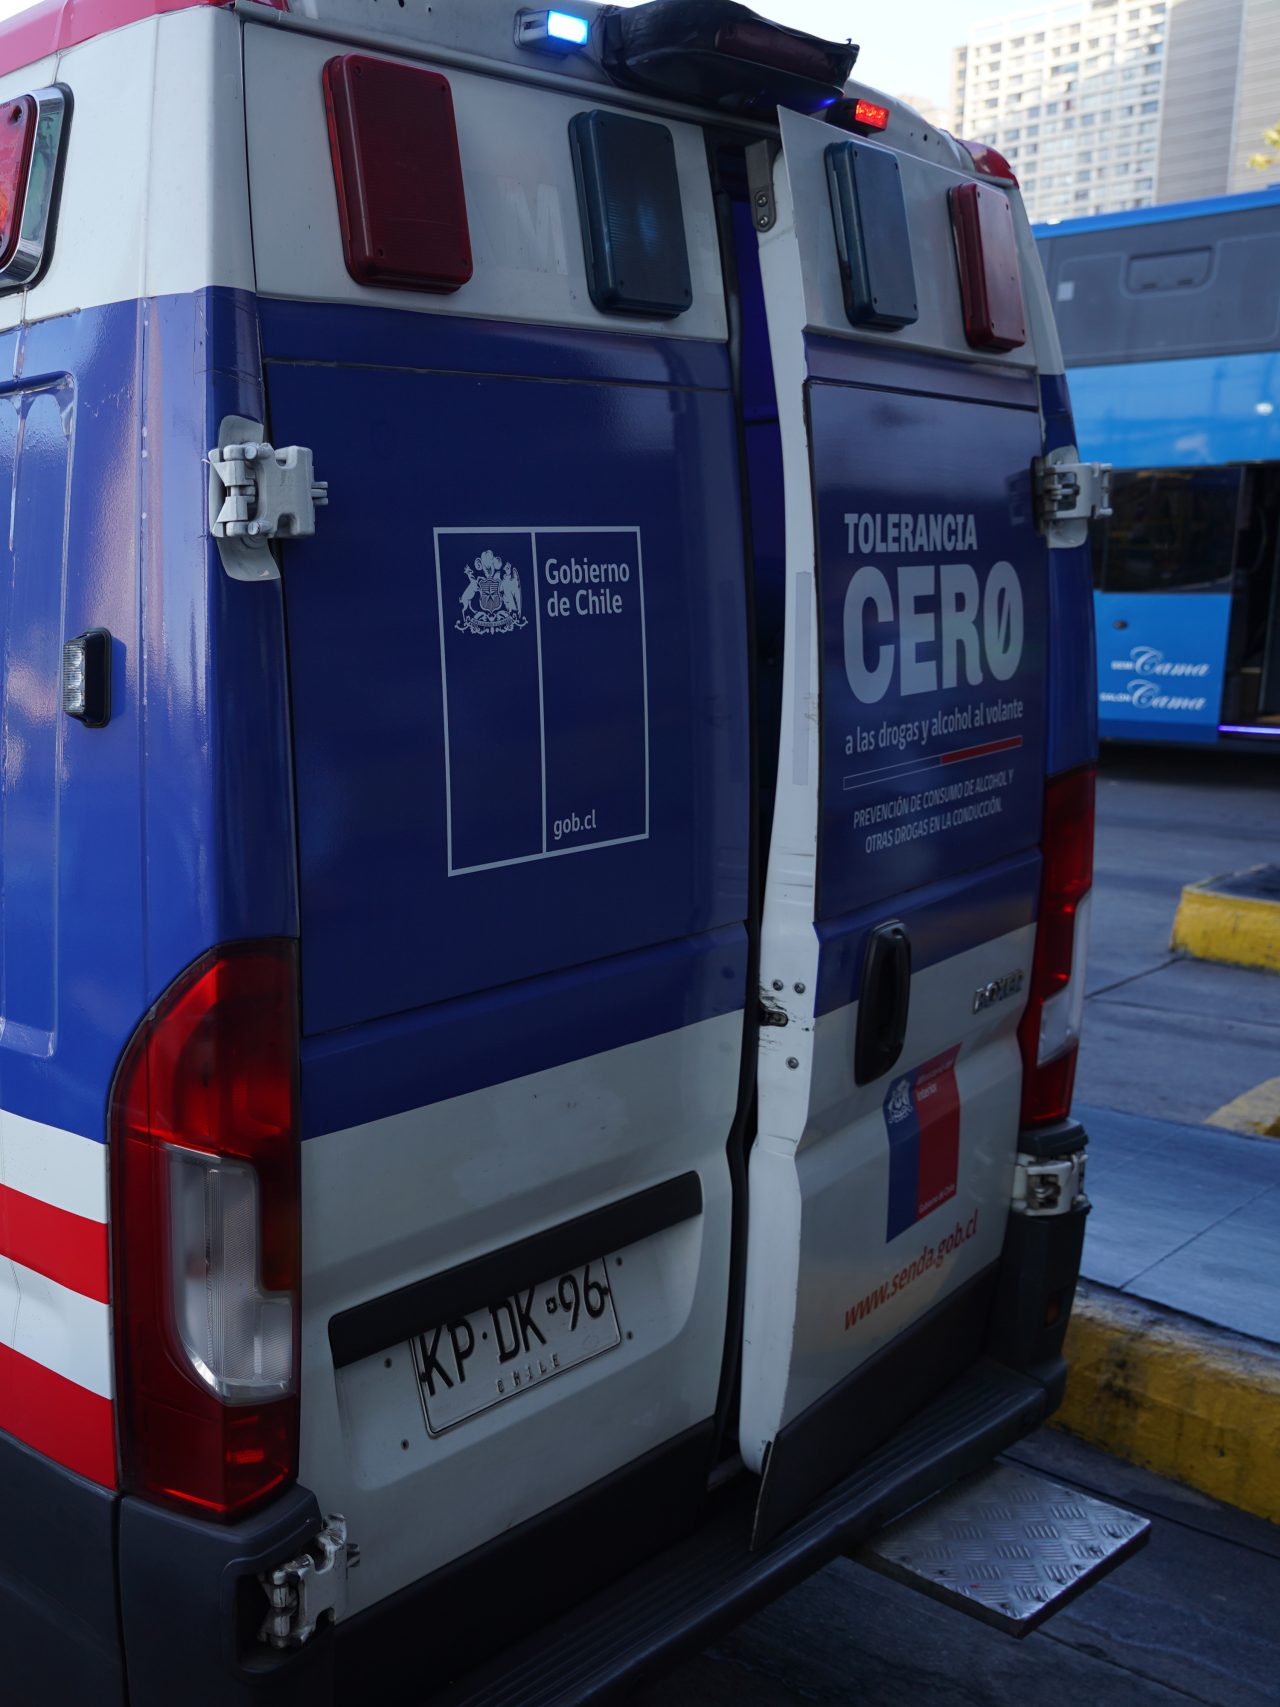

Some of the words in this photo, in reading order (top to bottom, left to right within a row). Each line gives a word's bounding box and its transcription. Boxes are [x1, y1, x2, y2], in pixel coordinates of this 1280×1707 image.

[844, 513, 978, 554] TOLERANCIA
[544, 557, 630, 585] Gobierno
[546, 591, 572, 618] de
[575, 588, 623, 616] Chile
[845, 734, 854, 755] a
[856, 726, 876, 752] las
[878, 721, 919, 750] drogas
[920, 720, 930, 746] y
[931, 705, 972, 737] alcohol
[973, 702, 985, 727] al
[985, 699, 1024, 724] volante
[854, 796, 910, 829] PREVENCIÓN
[910, 794, 922, 812] DE
[922, 782, 963, 809] CONSUMO
[963, 779, 975, 797] DE
[975, 771, 1008, 793] ALCOHOL
[1007, 768, 1015, 784] Y
[553, 809, 597, 840] gob.cl
[865, 830, 894, 854] OTRAS
[894, 818, 929, 846] DROGAS
[929, 815, 941, 834] EN
[941, 811, 952, 830] LA
[844, 1207, 978, 1331] www.senda.gob.cl
[496, 1352, 561, 1394] CHILE
